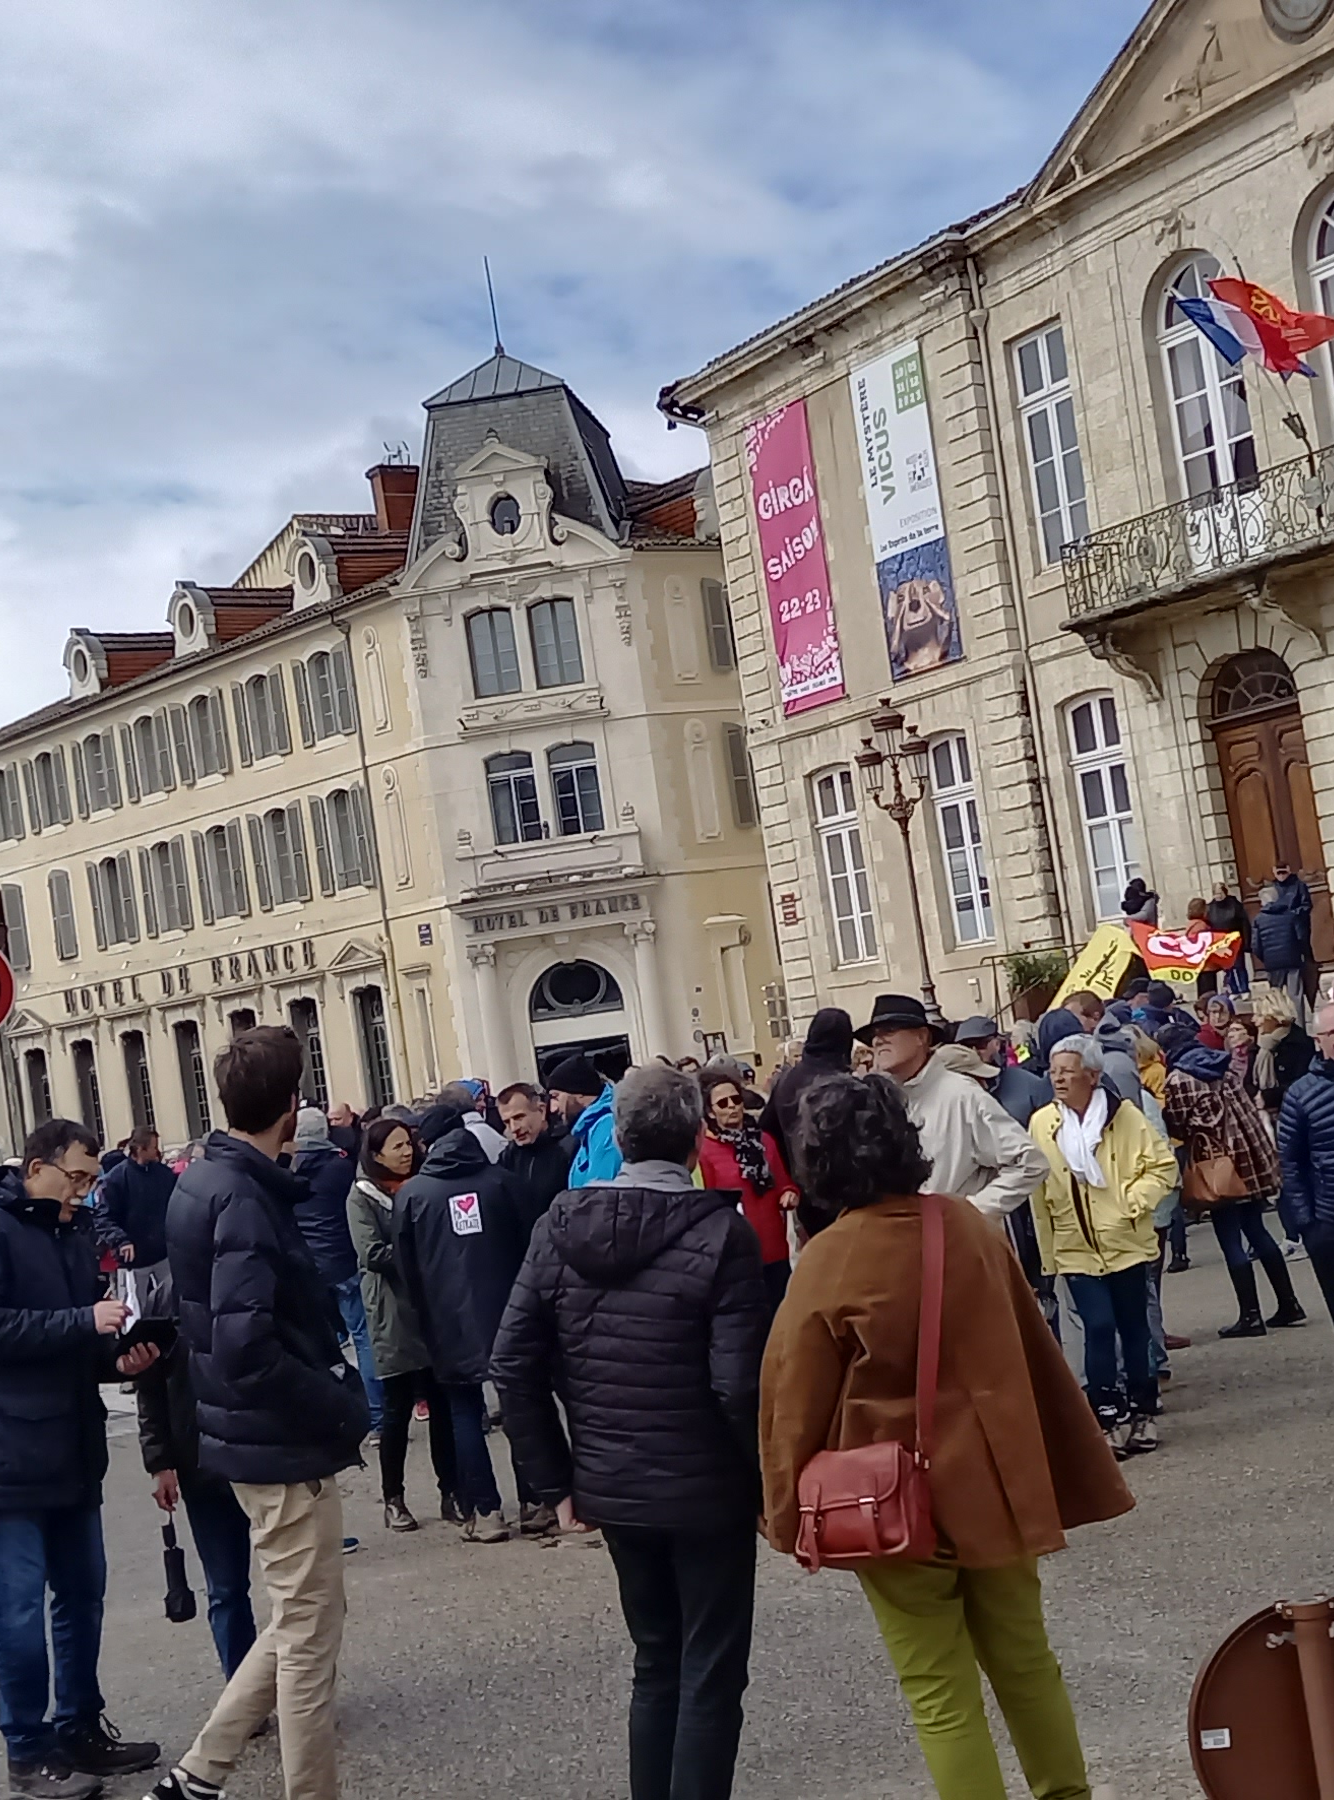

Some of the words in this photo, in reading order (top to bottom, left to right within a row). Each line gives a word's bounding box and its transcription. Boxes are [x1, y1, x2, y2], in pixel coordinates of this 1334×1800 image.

[869, 466, 878, 488] LE
[873, 407, 896, 505] VICUS
[473, 910, 529, 933] HOTEL
[538, 905, 560, 924] DE
[569, 894, 642, 919] FRANCE
[63, 975, 142, 1016] HOTEL
[161, 964, 193, 997] DE
[211, 939, 317, 986] FRANCE
